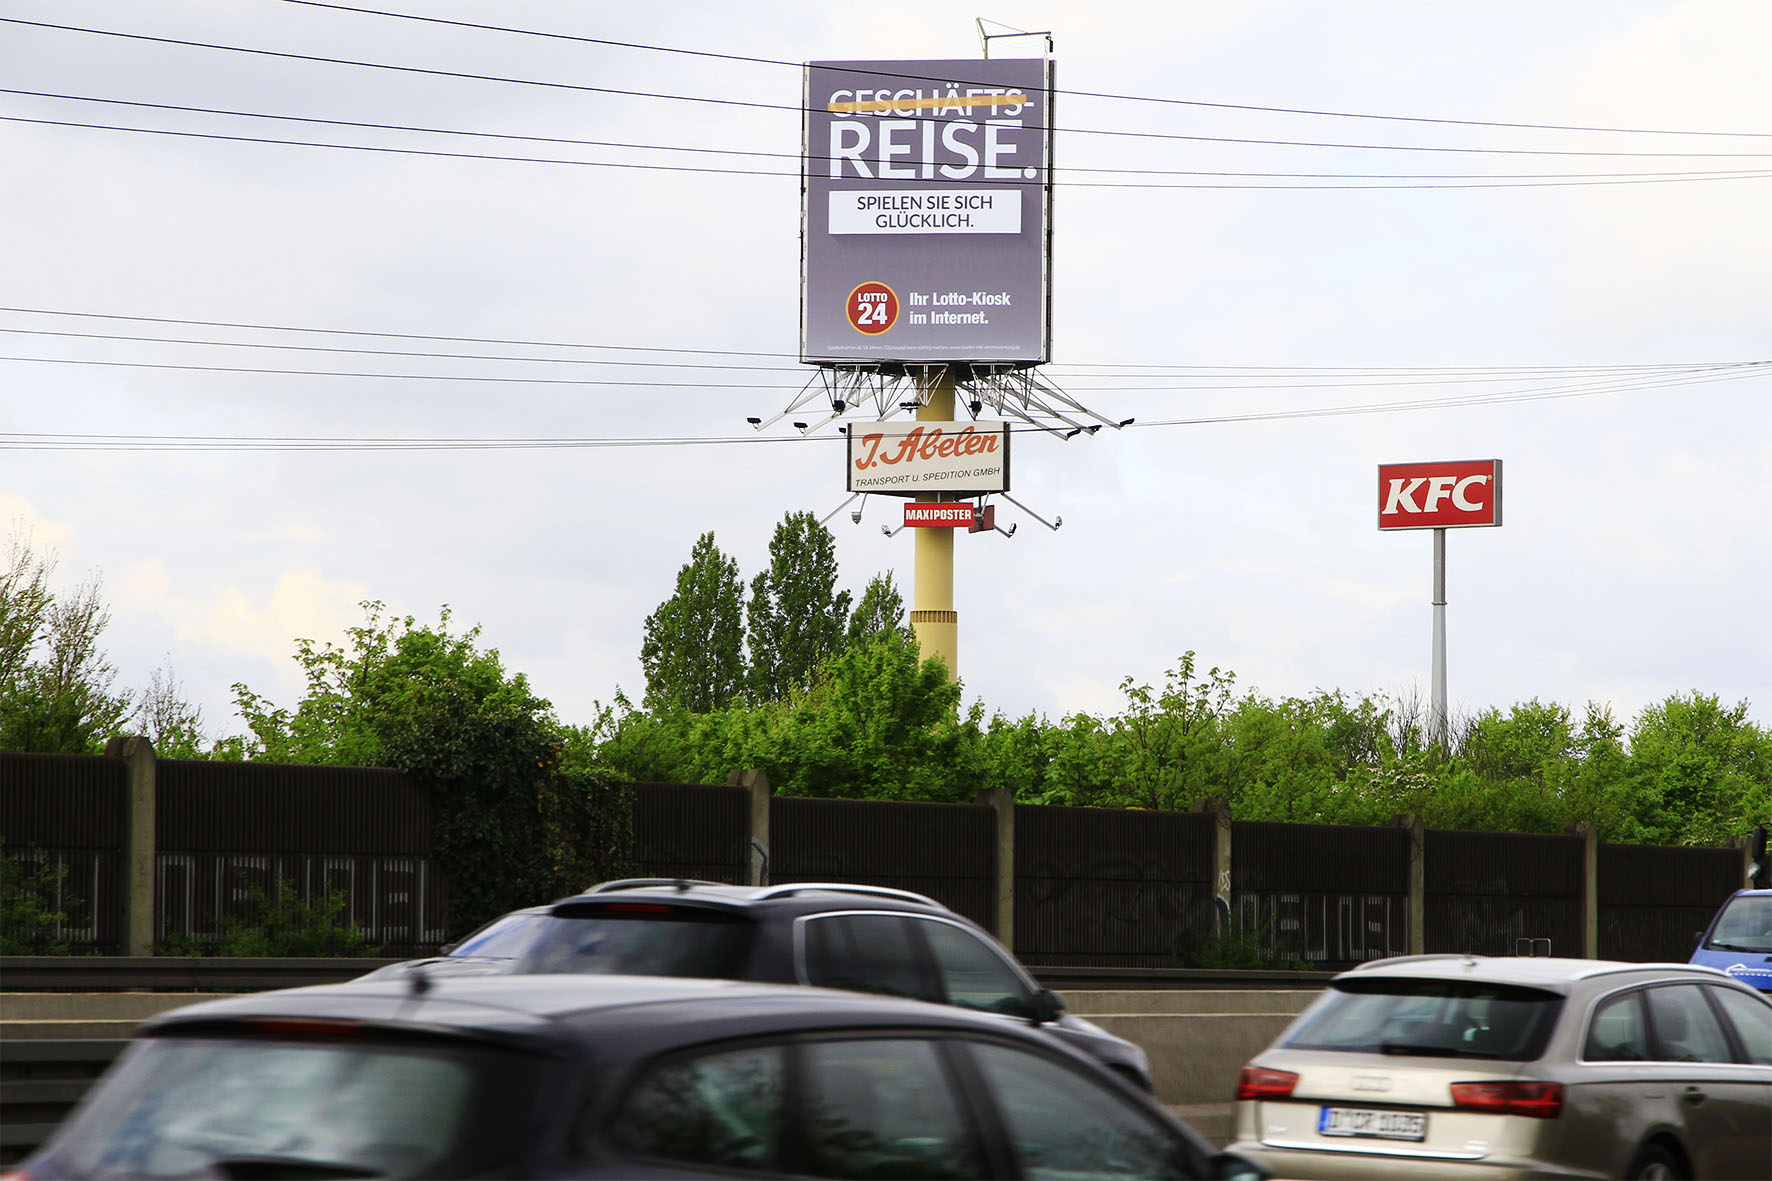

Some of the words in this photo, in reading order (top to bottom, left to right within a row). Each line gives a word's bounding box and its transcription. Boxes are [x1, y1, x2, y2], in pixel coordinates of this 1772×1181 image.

[828, 82, 1034, 117] GESCHÄFTS-
[830, 119, 1037, 179] REISE.
[857, 196, 922, 210] SPIELEN
[927, 196, 950, 209] SIE
[955, 195, 992, 209] SICH
[876, 212, 974, 228] GLÜCKLICH.
[858, 293, 888, 302] LOTTO
[909, 292, 929, 305] Ihr
[933, 292, 1011, 305] Lotto-Kiosk
[857, 303, 888, 325] 24
[909, 311, 927, 324] im
[931, 311, 988, 324] Internet.
[880, 426, 999, 465] Abelen
[856, 475, 910, 487] TRANSPORT
[923, 470, 970, 481] SPEDITION
[973, 467, 1000, 476] GMBH
[1382, 474, 1488, 514] KFC
[906, 510, 972, 520] MAXIPOSTER
